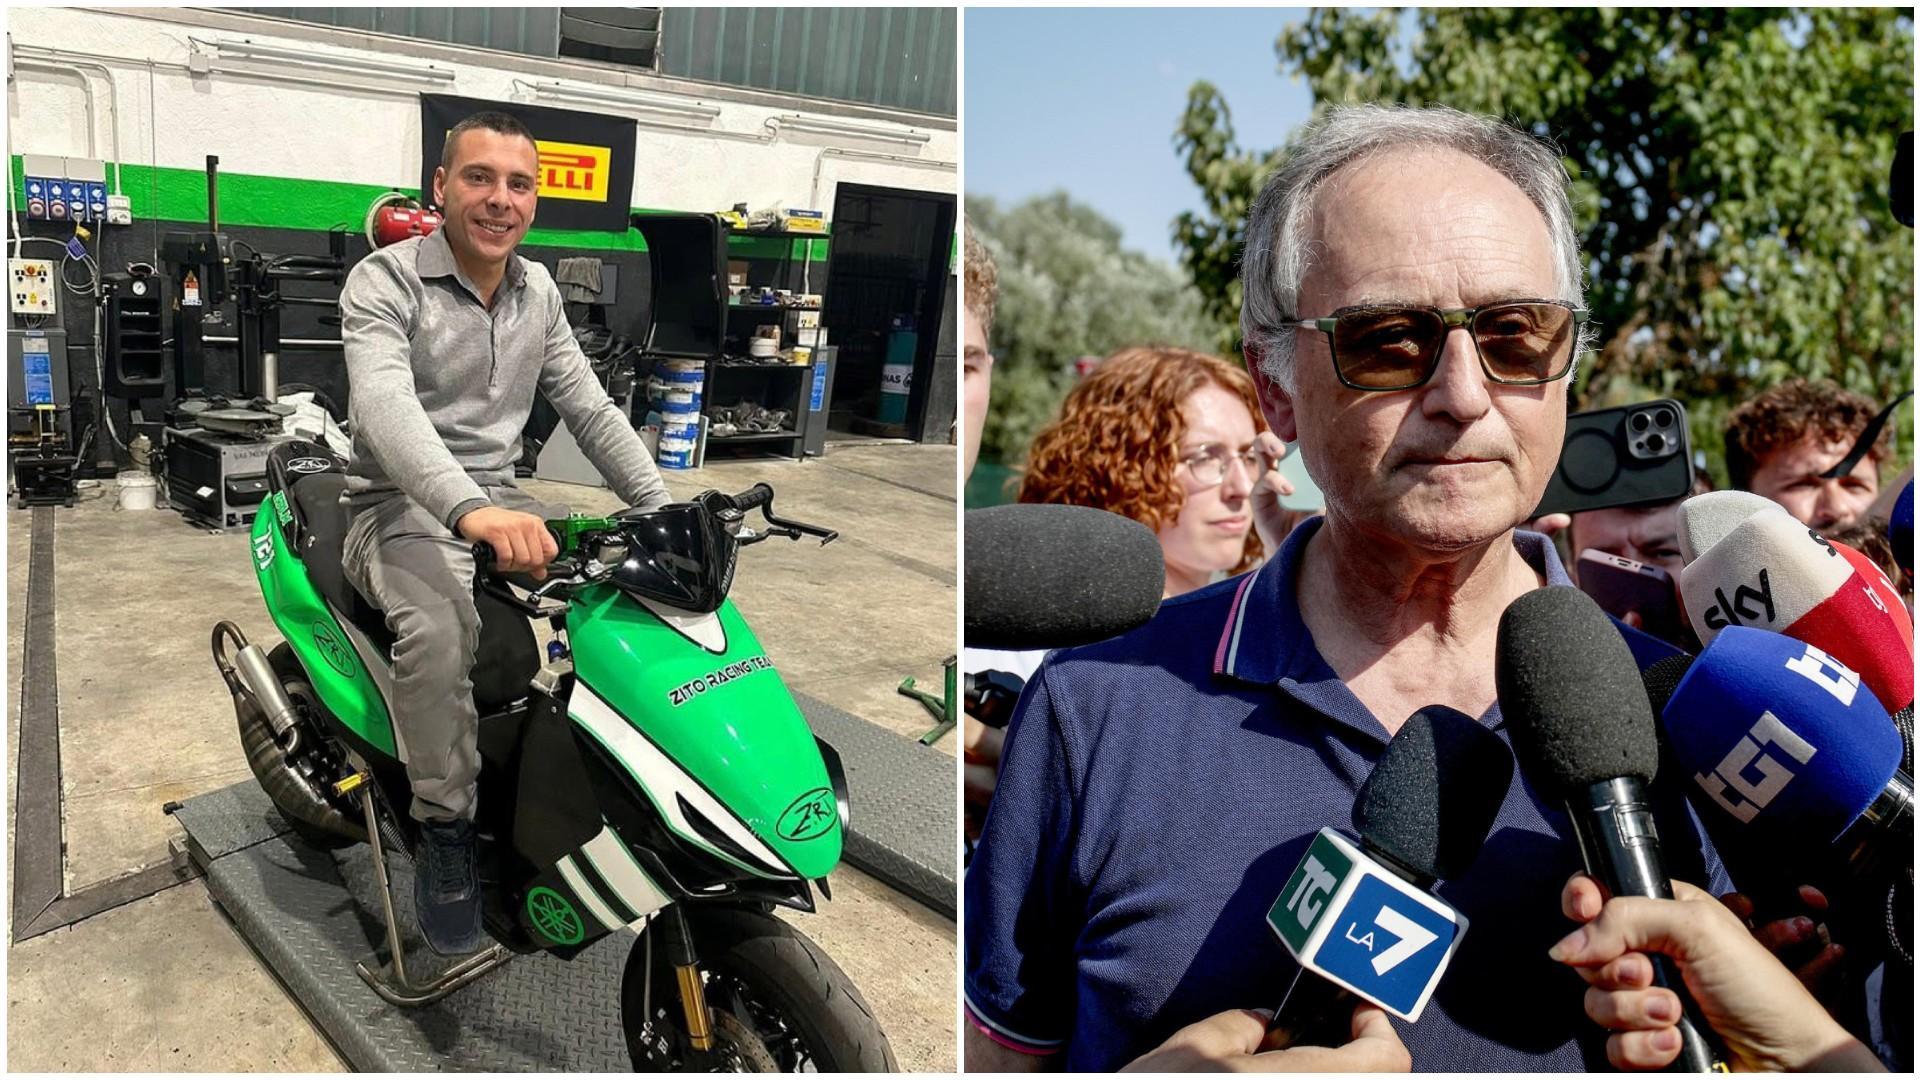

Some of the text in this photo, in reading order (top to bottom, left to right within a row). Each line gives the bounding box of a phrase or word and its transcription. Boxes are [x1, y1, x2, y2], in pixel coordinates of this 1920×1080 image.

[1704, 568, 1776, 630] sky
[668, 679, 706, 705] ZITO
[706, 660, 752, 687] RACING
[1286, 854, 1337, 931] TG
